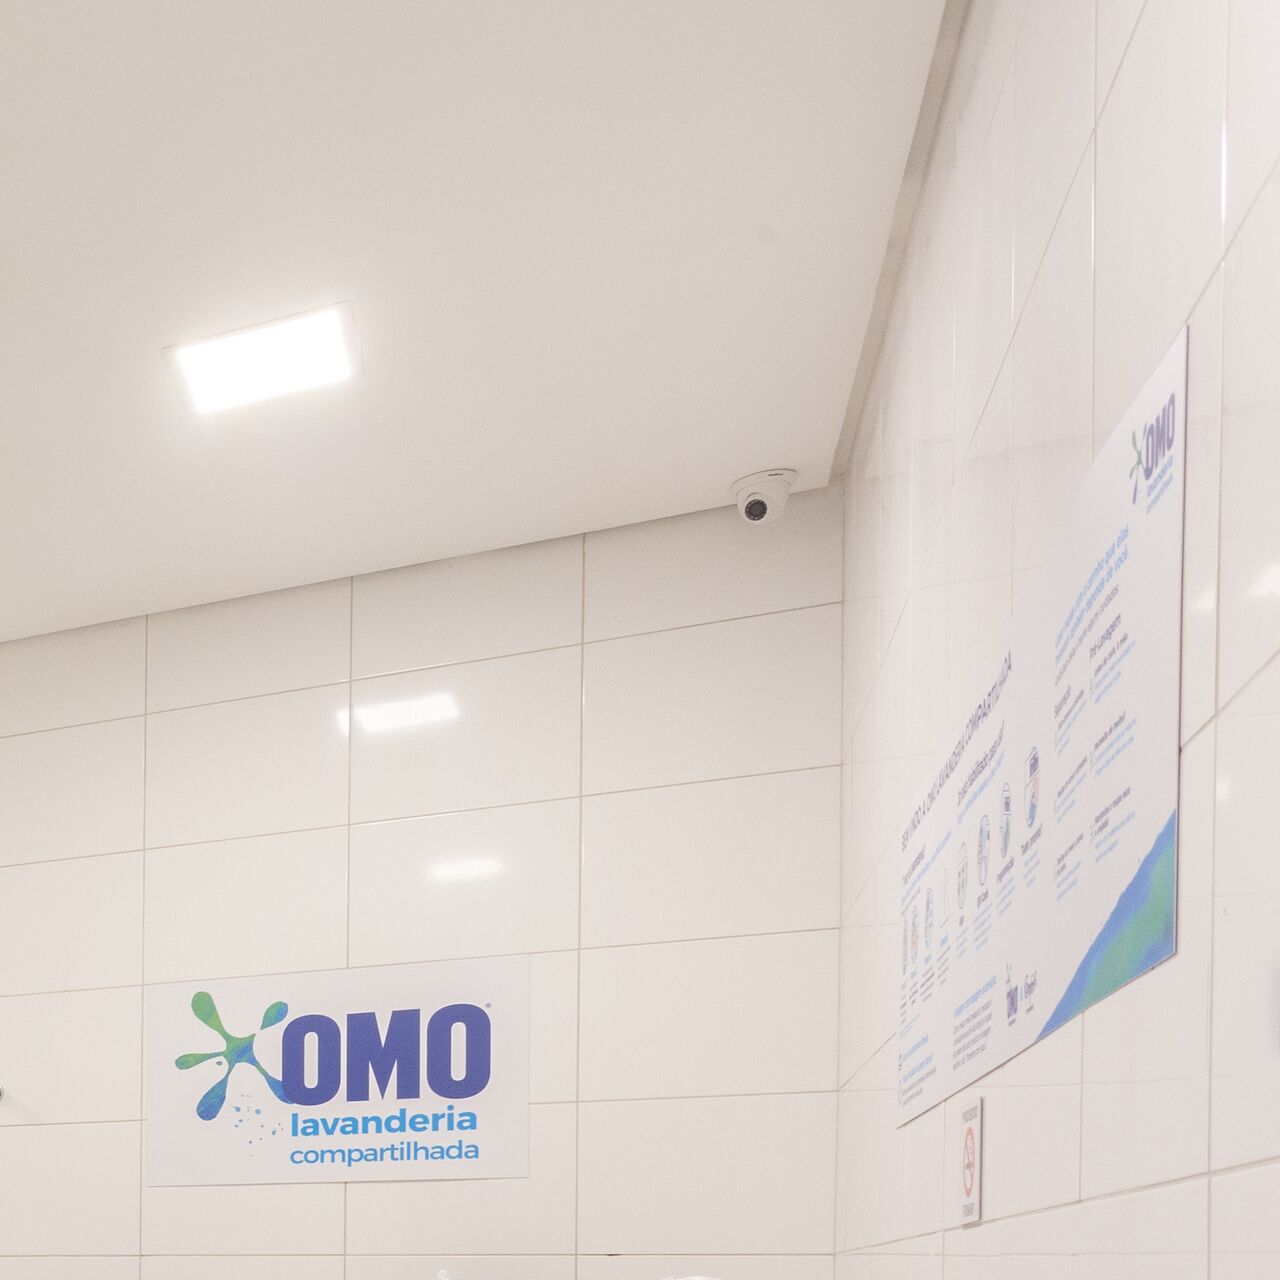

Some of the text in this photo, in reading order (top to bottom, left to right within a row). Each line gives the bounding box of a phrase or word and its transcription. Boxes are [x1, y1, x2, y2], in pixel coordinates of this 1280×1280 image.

[1144, 392, 1175, 481] OMO
[282, 1003, 491, 1106] OMO
[291, 1105, 478, 1137] lavanderia
[290, 1140, 480, 1167] compartilhada
